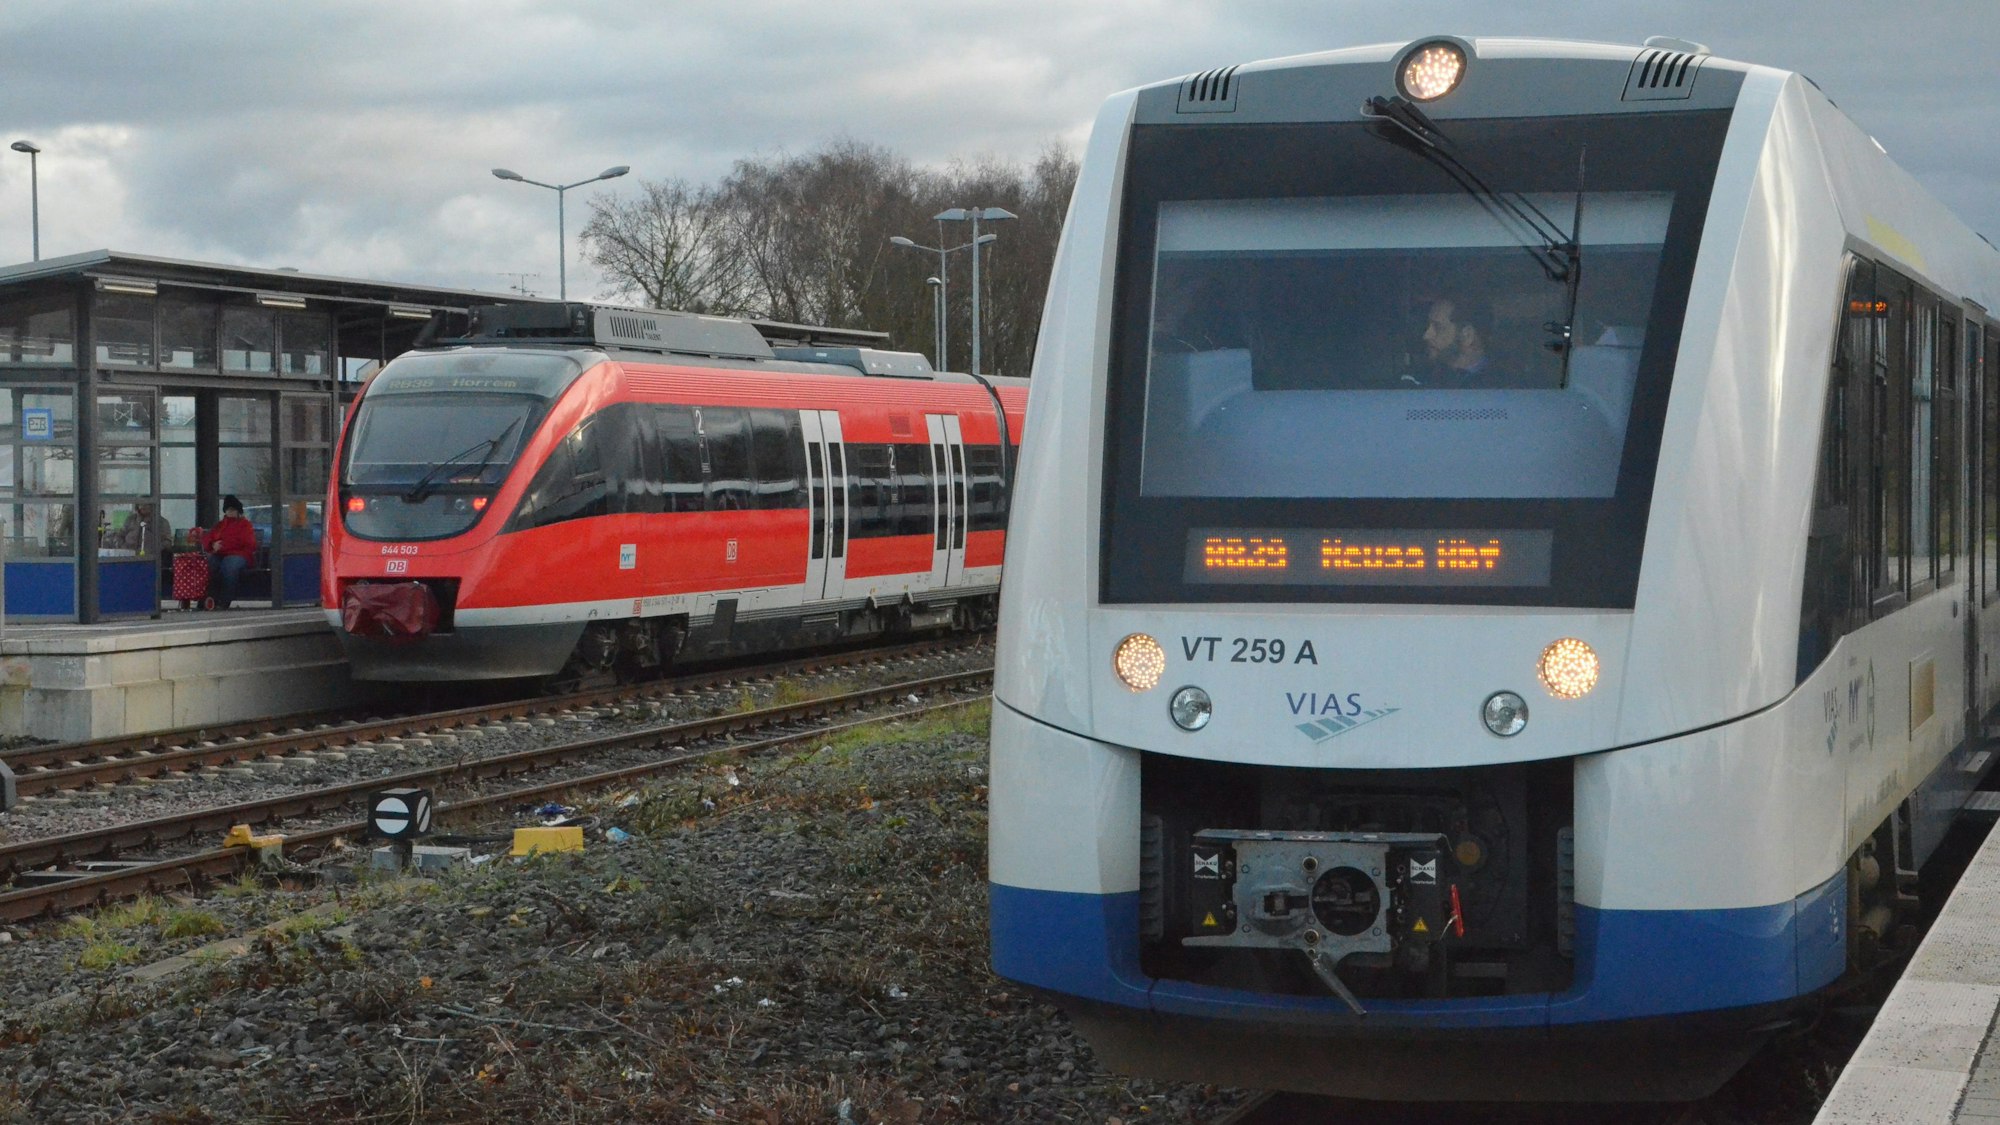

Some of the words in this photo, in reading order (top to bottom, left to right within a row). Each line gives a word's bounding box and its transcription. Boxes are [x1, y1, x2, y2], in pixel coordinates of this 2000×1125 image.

[452, 377, 517, 388] Horrem
[695, 409, 705, 435] 2
[381, 545, 398, 555] 644
[400, 545, 418, 555] 503
[1205, 537, 1287, 568] RB39
[1322, 538, 1424, 568] Neuss
[1437, 539, 1499, 569] Hbf
[387, 560, 406, 572] DB
[1181, 636, 1222, 662] VT
[1231, 637, 1286, 664] 259
[1294, 639, 1319, 665] A
[1286, 692, 1362, 717] VIAS
